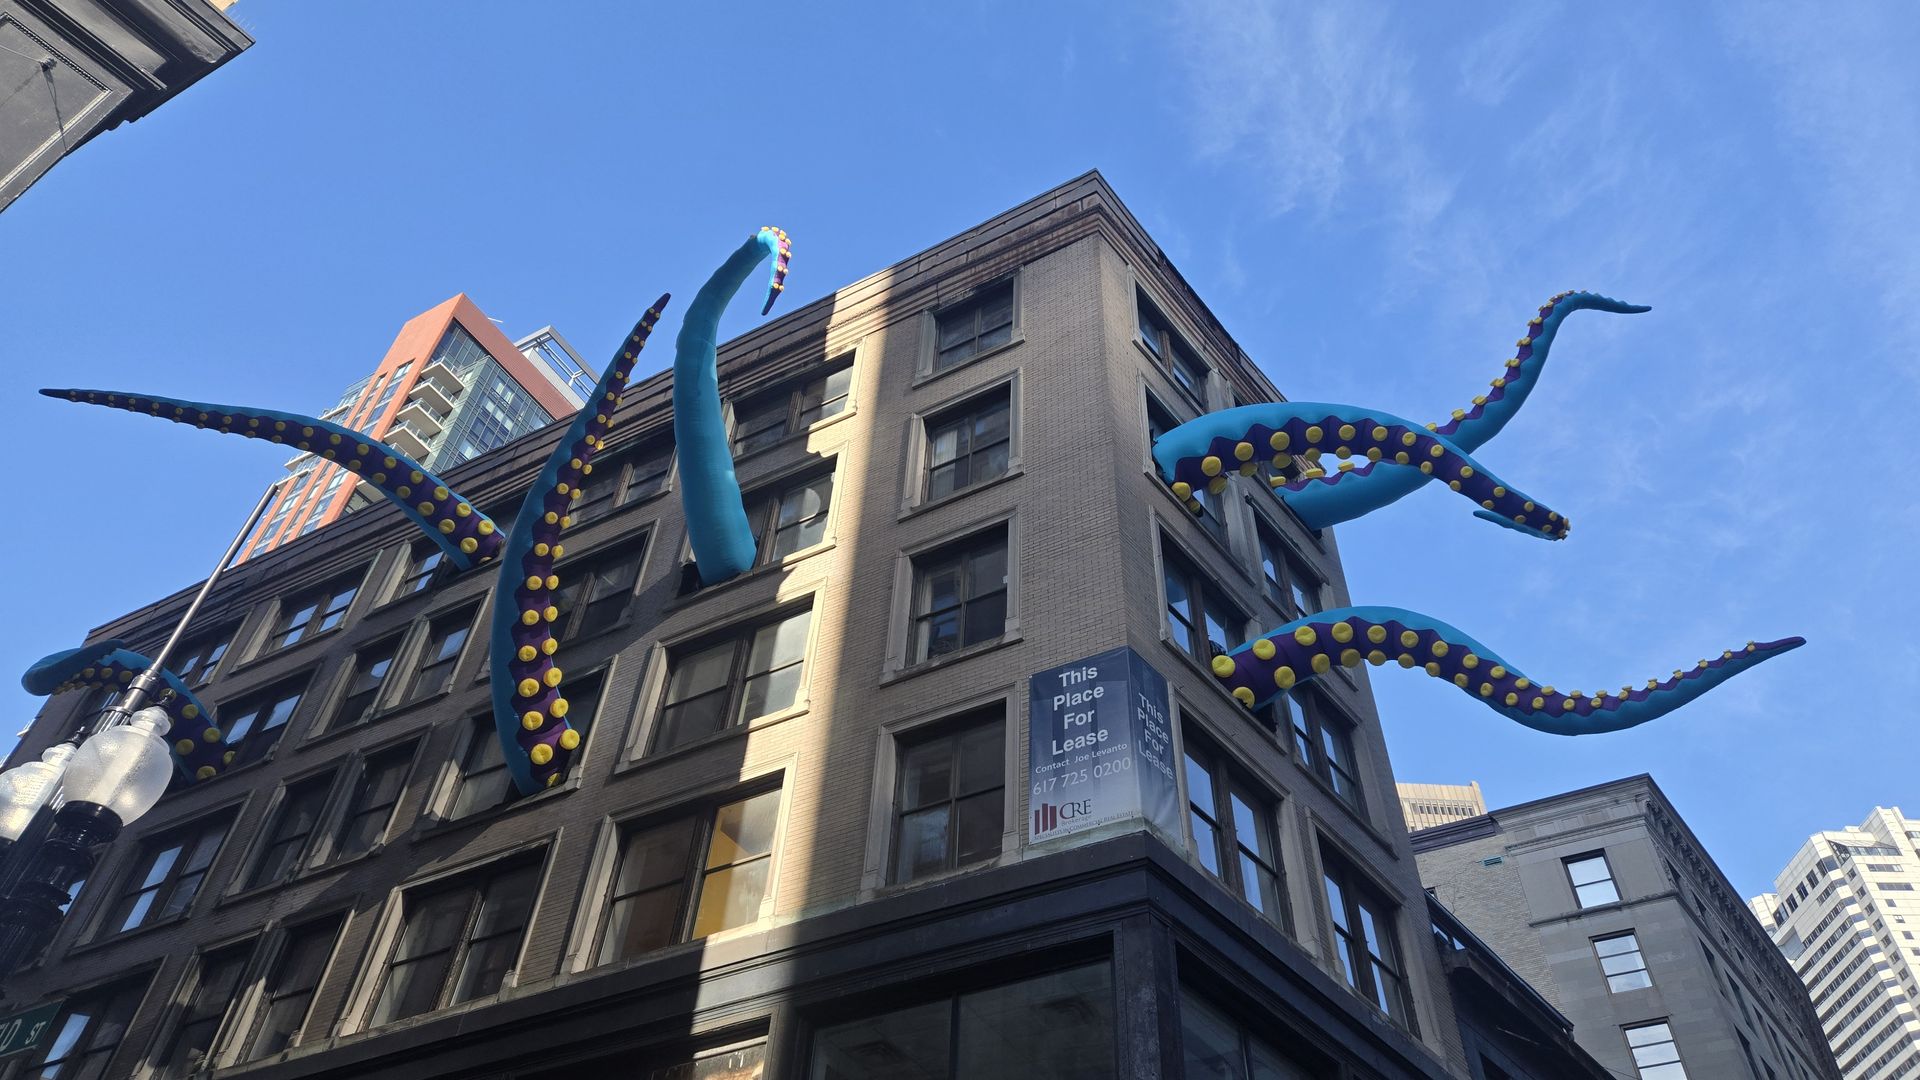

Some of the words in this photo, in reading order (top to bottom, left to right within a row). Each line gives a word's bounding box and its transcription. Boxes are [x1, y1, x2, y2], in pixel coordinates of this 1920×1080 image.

[1059, 666, 1098, 687] This
[1053, 686, 1105, 711] Place
[1138, 692, 1164, 724] This
[1064, 710, 1095, 729] For
[1137, 707, 1169, 744] Place
[1052, 729, 1109, 755] Lease
[1144, 728, 1164, 754] For
[1035, 759, 1070, 774] Contact
[1074, 754, 1090, 764] Joe
[1091, 743, 1128, 758] Levanto
[1138, 740, 1174, 780] Lease
[1033, 777, 1057, 795] 617
[1061, 769, 1088, 788] 725
[1093, 757, 1131, 778] 0200
[1060, 799, 1092, 819] CRE
[25, 1021, 47, 1045] ST
